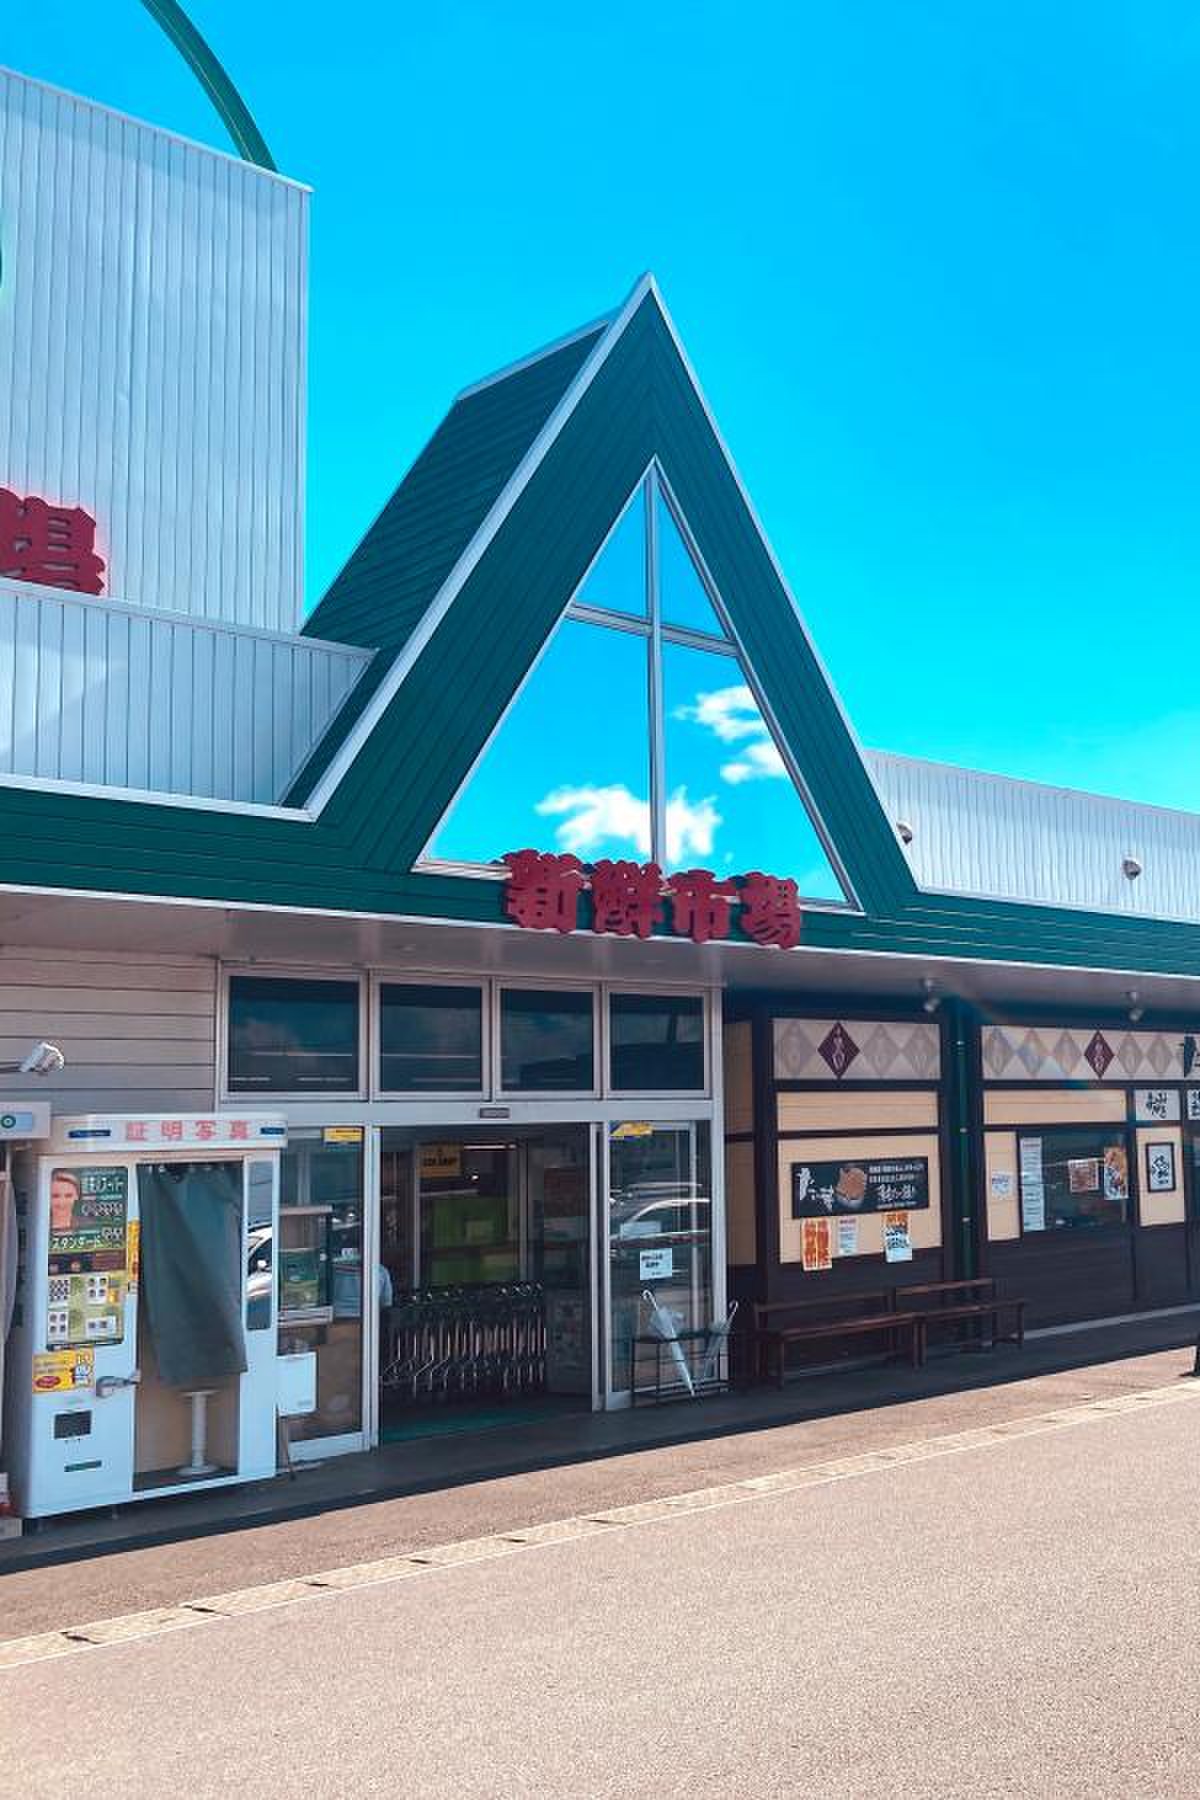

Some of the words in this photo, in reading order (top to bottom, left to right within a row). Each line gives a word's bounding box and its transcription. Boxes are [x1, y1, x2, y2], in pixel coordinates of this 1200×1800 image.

[507, 849, 800, 949] 新鮮市場
[126, 1120, 248, 1142] 証明写真
